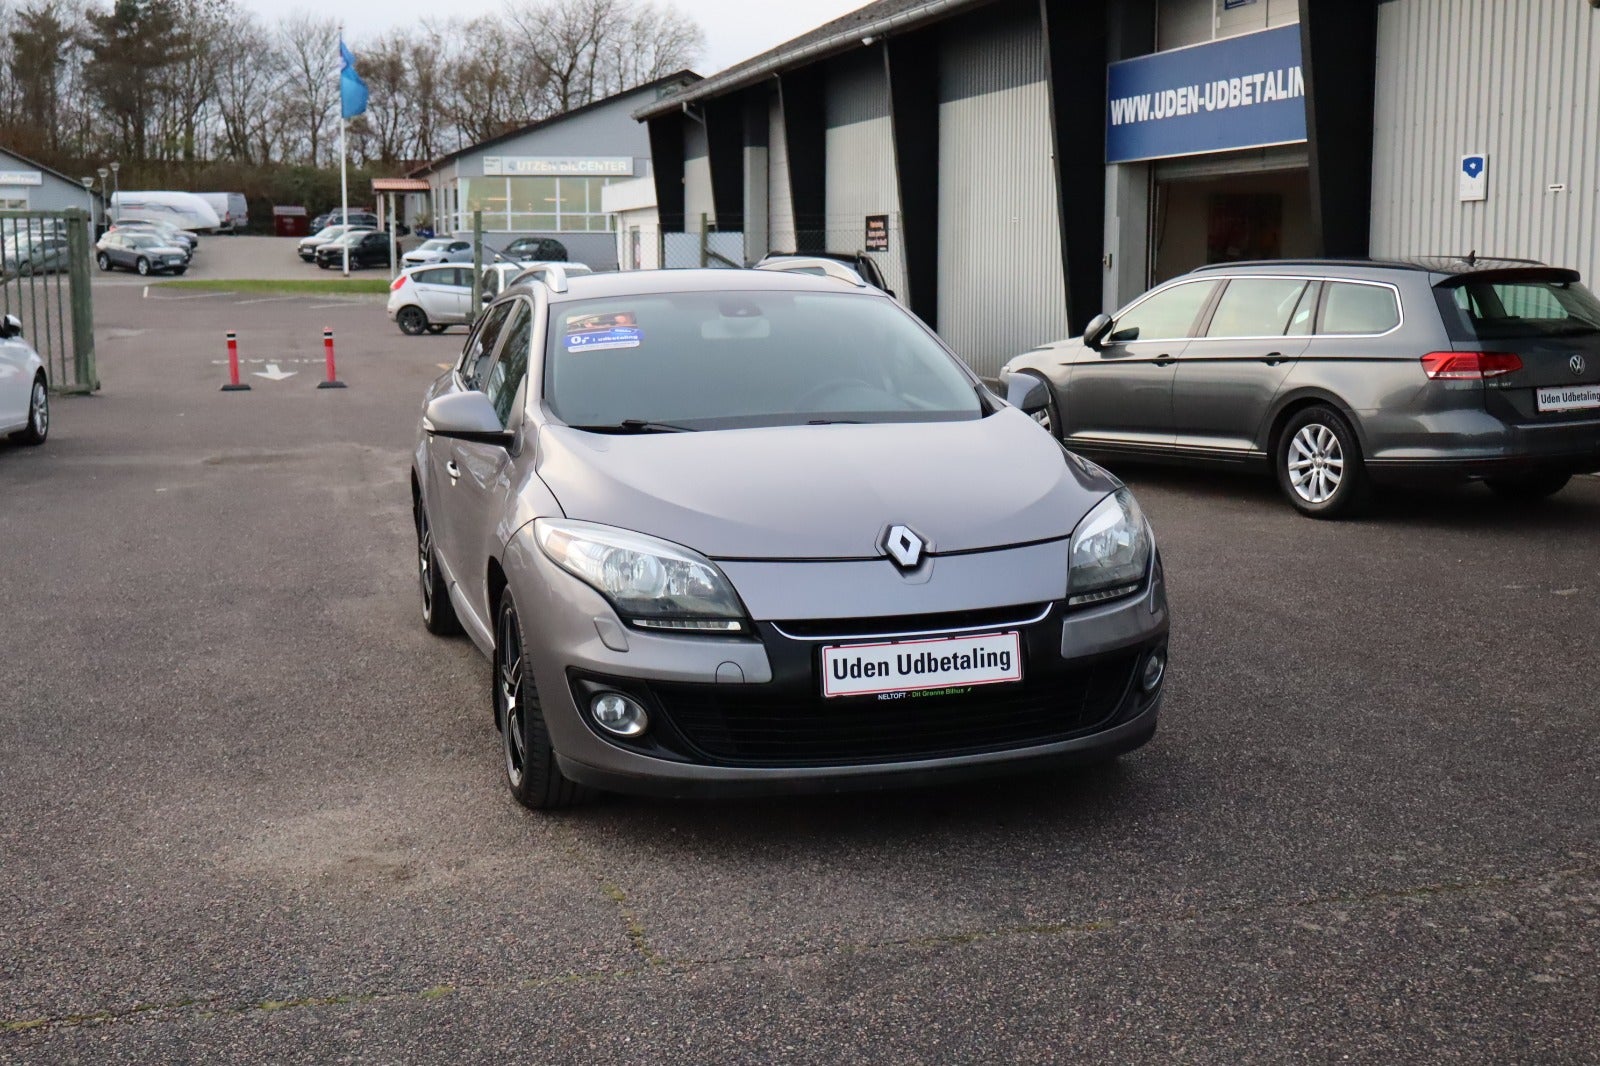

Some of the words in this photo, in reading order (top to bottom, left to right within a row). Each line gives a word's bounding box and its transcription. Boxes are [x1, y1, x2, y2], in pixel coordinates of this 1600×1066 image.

[1540, 393, 1560, 404] Uden
[1562, 390, 1600, 403] Udbetaling
[832, 657, 889, 680] Uden
[897, 646, 1011, 676] Udbetaling
[877, 692, 906, 700] NELTOFT
